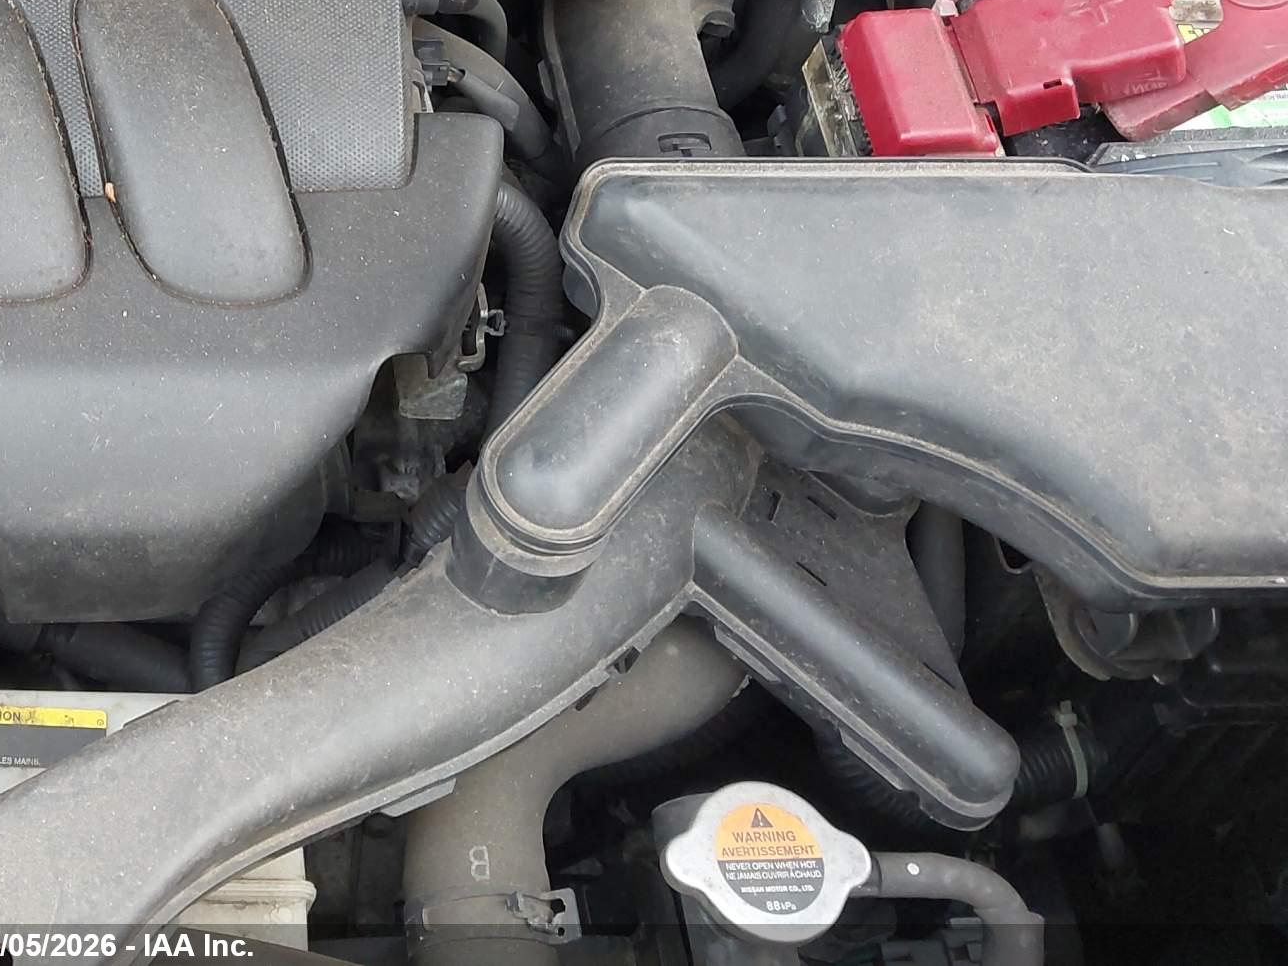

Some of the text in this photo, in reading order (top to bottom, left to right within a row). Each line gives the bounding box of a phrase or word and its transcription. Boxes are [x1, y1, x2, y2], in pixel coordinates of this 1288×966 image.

[732, 830, 797, 843] WARNING
[721, 845, 816, 857] AVERTISSEMENT
[726, 860, 819, 871] NEVER OPEN WHEN HOT.
[802, 884, 815, 892] LTD.
